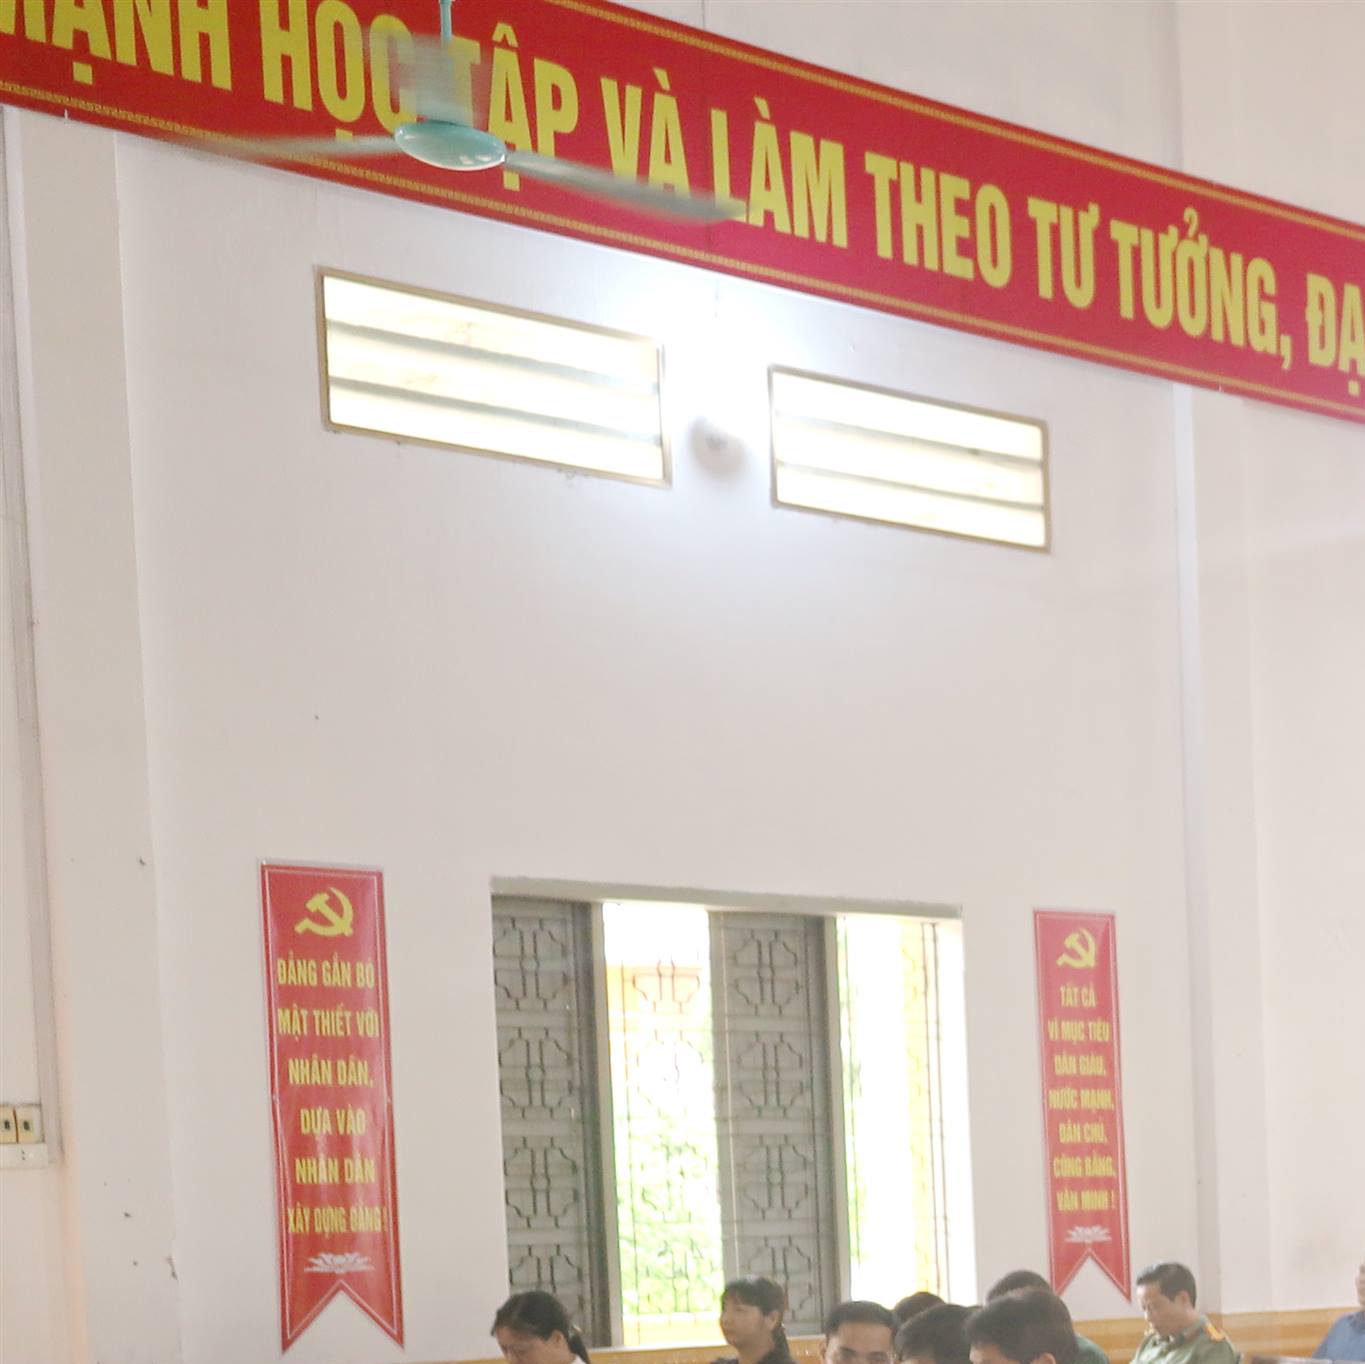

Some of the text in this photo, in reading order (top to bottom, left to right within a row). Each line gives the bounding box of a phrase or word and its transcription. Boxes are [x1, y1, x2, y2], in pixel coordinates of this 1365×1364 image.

[601, 67, 692, 198] VÀ
[710, 97, 848, 249] LÀM
[865, 150, 1012, 289] THEO
[1027, 197, 1099, 310] TƯ
[1109, 207, 1292, 370] TƯỞNG,
[277, 949, 318, 987] ĐẢNG
[321, 951, 352, 988] GẮN
[278, 1003, 308, 1042] MẬT
[313, 1002, 352, 1037] THIẾT
[288, 1053, 333, 1085] NHÂN
[300, 1103, 367, 1140] DỰA VÀO
[295, 1152, 376, 1184] NHÂN DÂN
[287, 1201, 311, 1234] XÂY
